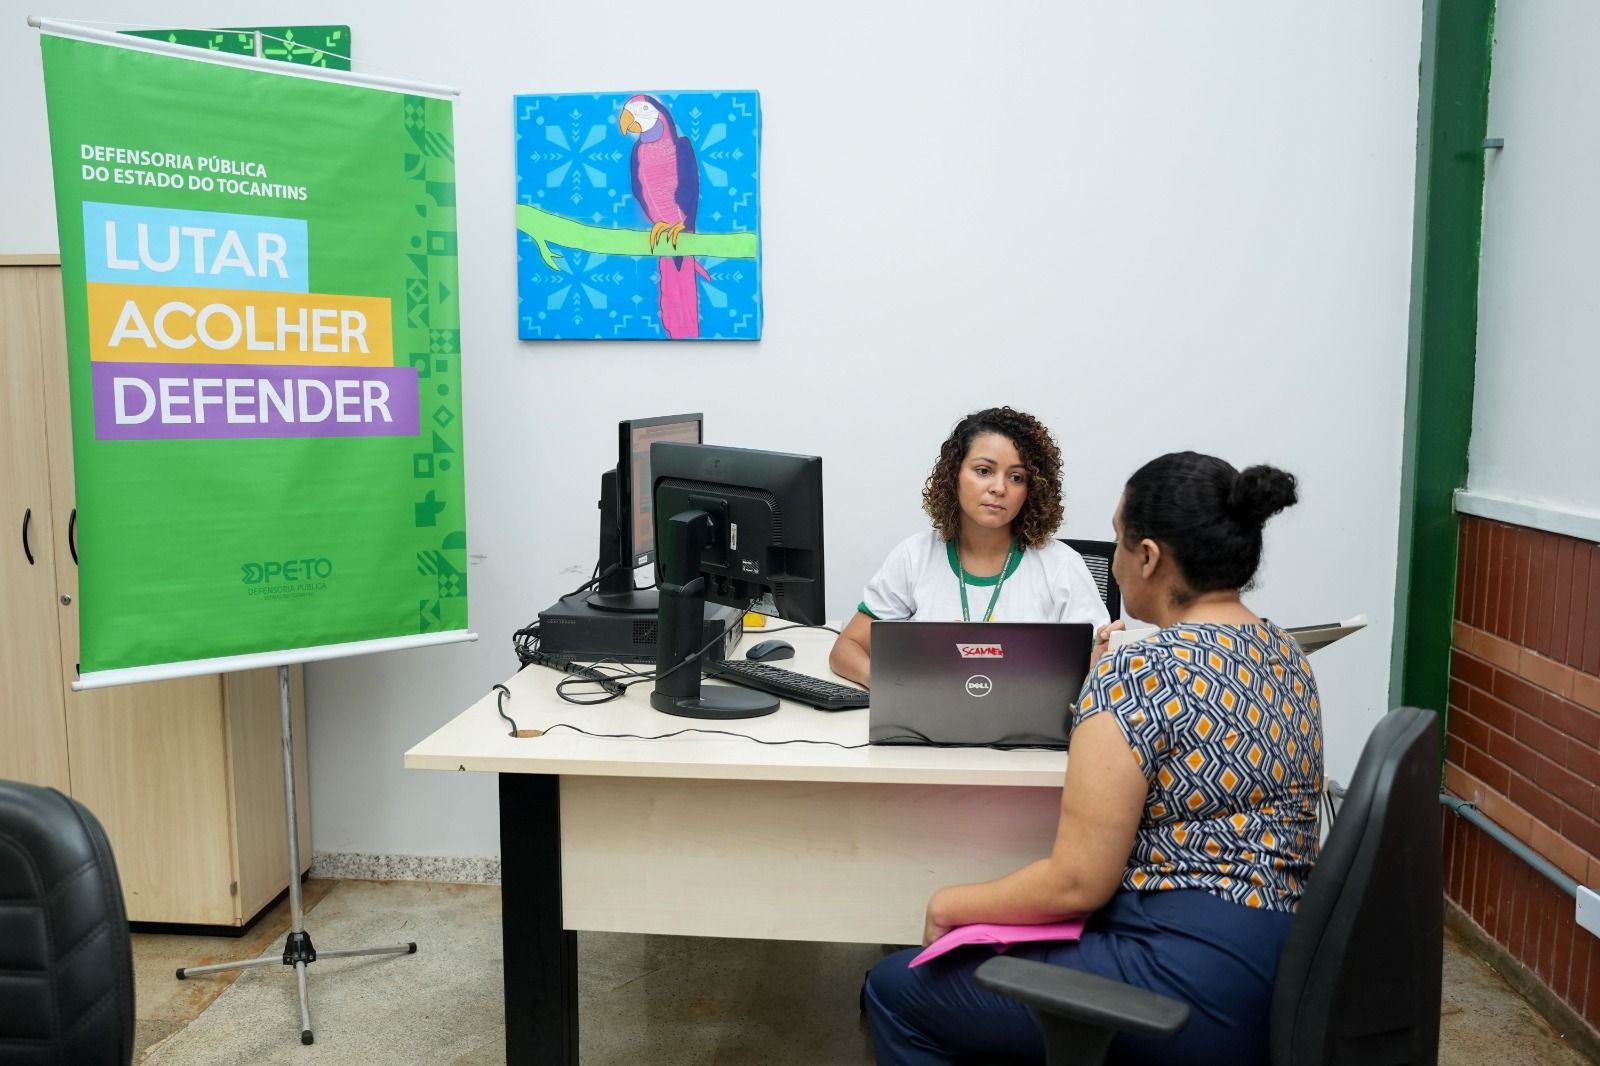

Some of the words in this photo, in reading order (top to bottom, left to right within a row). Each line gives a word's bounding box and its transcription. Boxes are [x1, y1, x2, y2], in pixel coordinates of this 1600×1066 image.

[81, 144, 194, 170] DEFENSORIA
[198, 155, 267, 178] PÚBLICA
[82, 165, 109, 182] DO
[114, 169, 184, 189] ESTADO
[188, 175, 214, 192] DO
[217, 178, 308, 201] TOCANTINS
[105, 220, 289, 279] LUTAR
[108, 299, 370, 354] ACOLHER
[113, 377, 393, 425] DEFENDER
